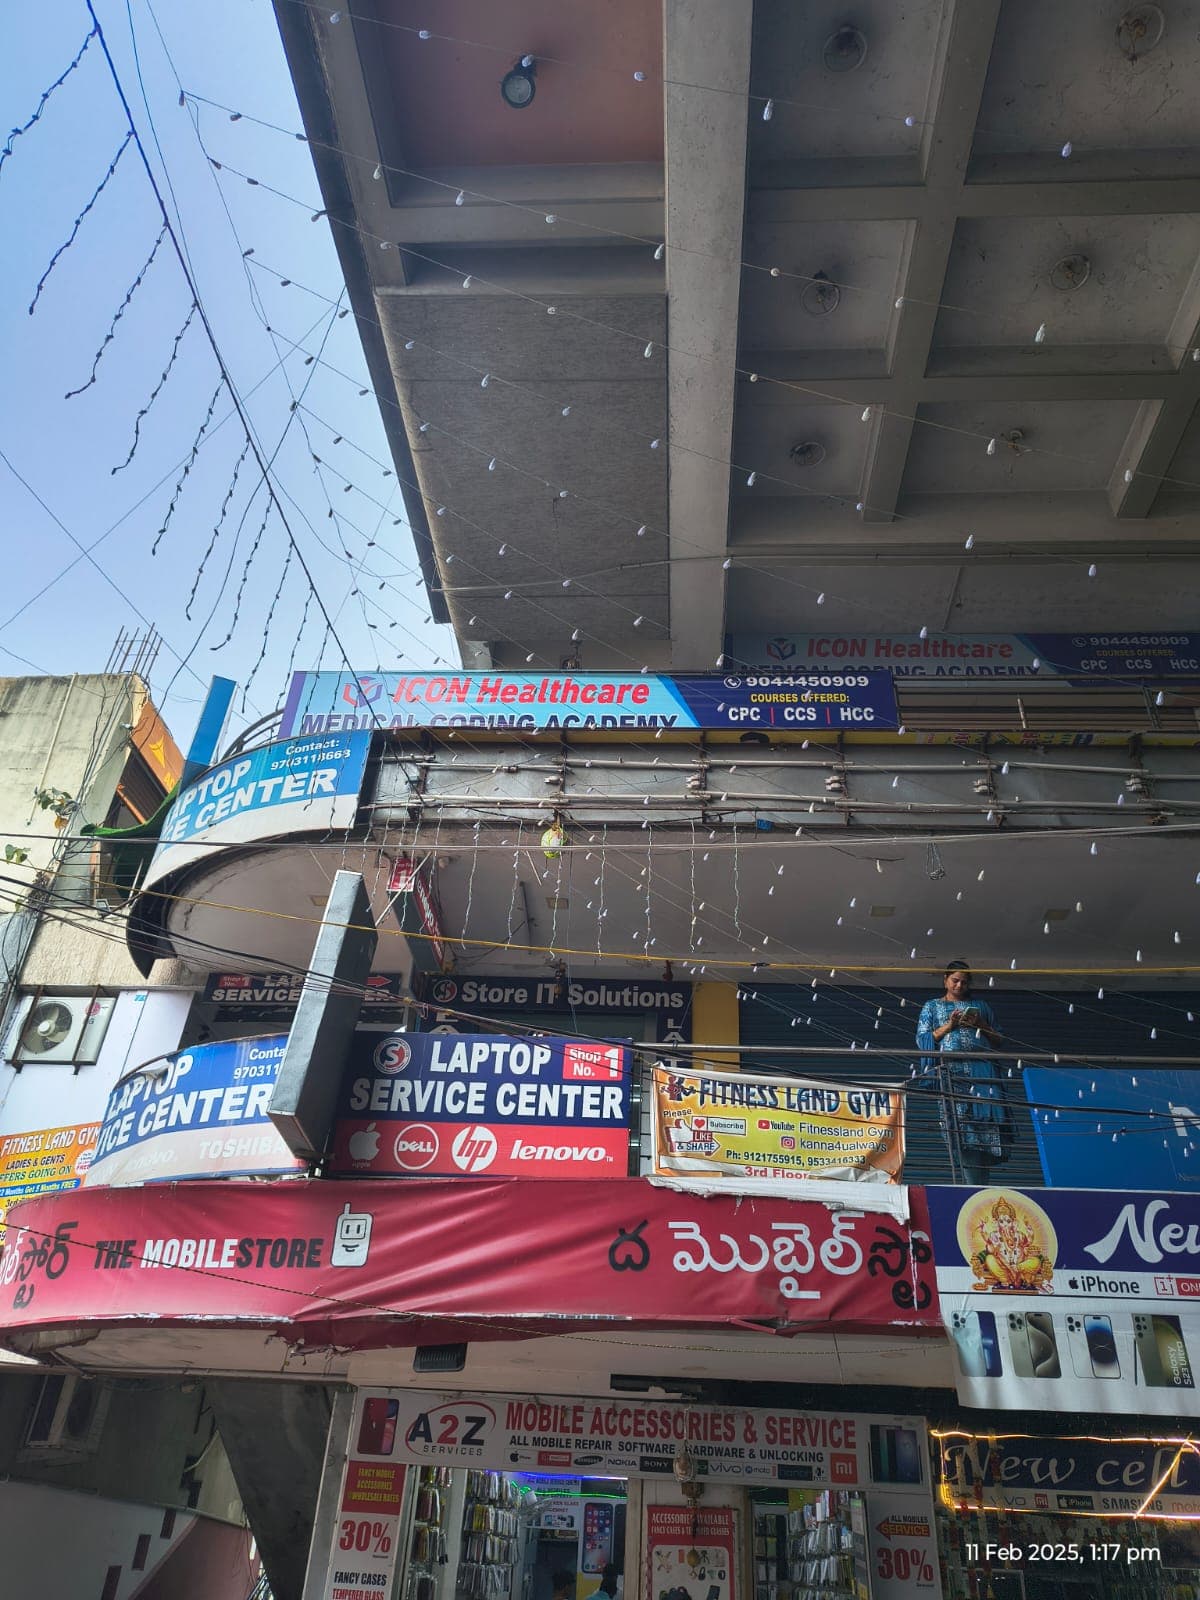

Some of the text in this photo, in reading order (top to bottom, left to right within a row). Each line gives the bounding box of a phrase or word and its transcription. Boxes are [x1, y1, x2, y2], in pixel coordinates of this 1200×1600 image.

[807, 638, 1013, 658] ICON Healthcare
[1089, 637, 1190, 646] 9044450909
[1080, 659, 1198, 670] CPC CCS HCC
[746, 676, 869, 687] 9044450909
[393, 677, 649, 704] ICON Healthcare
[751, 693, 850, 703] COURSES OFFERED:
[728, 707, 874, 721] CPC CCS HCC
[285, 739, 340, 755] Contact:
[195, 768, 338, 829] CENTER
[211, 988, 301, 1001] SERVICE
[461, 981, 528, 1002] Store
[535, 983, 558, 1004] IT
[567, 984, 684, 1008] Solutions
[430, 1040, 552, 1076] LAPTOP
[569, 1047, 619, 1077] Shop 1
[573, 1063, 596, 1077] No.
[350, 1078, 625, 1120] SERVICE CENTER
[699, 1078, 891, 1118] FITNESS LAND GYM
[137, 1083, 275, 1137] CENTER
[663, 1109, 692, 1117] Please
[710, 1121, 744, 1129] Subscribe
[770, 1121, 894, 1139] YouTube Fitnessland Gym
[0, 1134, 45, 1157] FITNESS
[44, 1129, 76, 1151] LAND
[694, 1132, 712, 1141] LIKE
[398, 1140, 434, 1153] DELL
[509, 1139, 606, 1162] lenovo
[686, 1142, 715, 1151] SHARE
[799, 1138, 888, 1153] kanna4ualways
[6, 1158, 31, 1170] LADIES
[40, 1154, 66, 1166] GENTS
[726, 1150, 741, 1160] Ph:
[743, 1151, 805, 1167] 9121755915,
[28, 1167, 56, 1179] GOING
[58, 1165, 72, 1176] ON
[744, 1166, 768, 1178] 3rd
[94, 1238, 323, 1269] THE MOBILESTORE
[608, 1219, 651, 1273] ద
[667, 1211, 865, 1299] మొబైల్
[1081, 1276, 1141, 1294] iPhone
[1180, 1282, 1200, 1293] ON
[1167, 1345, 1181, 1385] Galaxy
[408, 1413, 488, 1446] A2Z
[505, 1402, 857, 1449] MOBILE ACCESSORIES & SERVICE
[423, 1444, 483, 1456] SERVICES
[509, 1435, 529, 1446] ALL
[532, 1436, 572, 1449] MOBILE
[574, 1438, 613, 1451] REPAIR
[618, 1440, 675, 1454] SOFTWARE
[748, 1448, 756, 1459] &
[760, 1448, 825, 1462] UNLOCKING
[607, 1458, 637, 1467] NOKIA
[643, 1460, 669, 1468] SONY
[944, 1444, 1076, 1485] New
[1102, 1497, 1164, 1512] SAMSNG
[339, 1520, 392, 1553] 30%
[882, 1525, 929, 1536] SERVICE
[877, 1547, 934, 1581] 30%
[334, 1571, 387, 1587] FANCY CASES
[331, 1588, 363, 1600] TEMPERED
